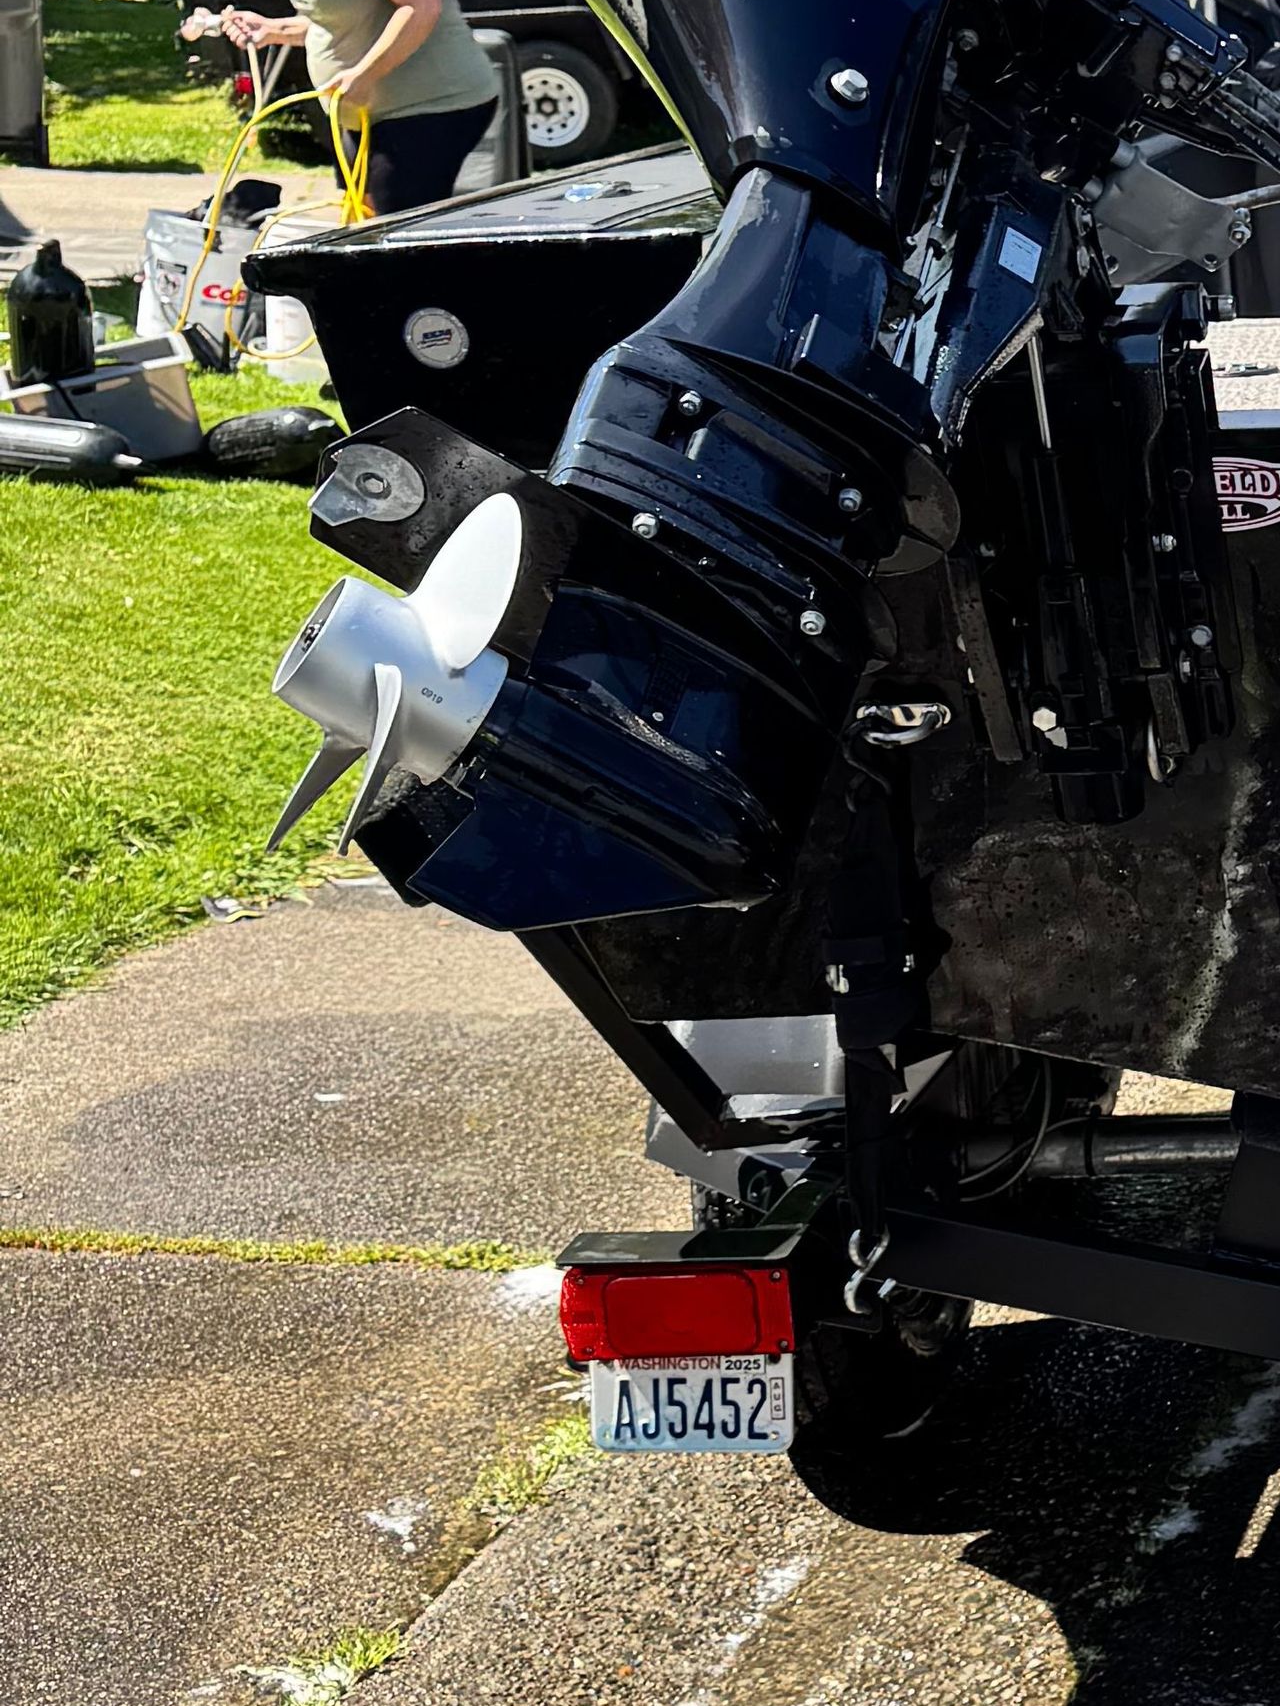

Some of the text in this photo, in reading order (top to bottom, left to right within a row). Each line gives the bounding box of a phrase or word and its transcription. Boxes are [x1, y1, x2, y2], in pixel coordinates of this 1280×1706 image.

[1220, 504, 1250, 519] LL
[619, 1356, 762, 1371] WASHINGTON 2025
[773, 1382, 782, 1412] AUG
[614, 1377, 769, 1440] AJ5452
